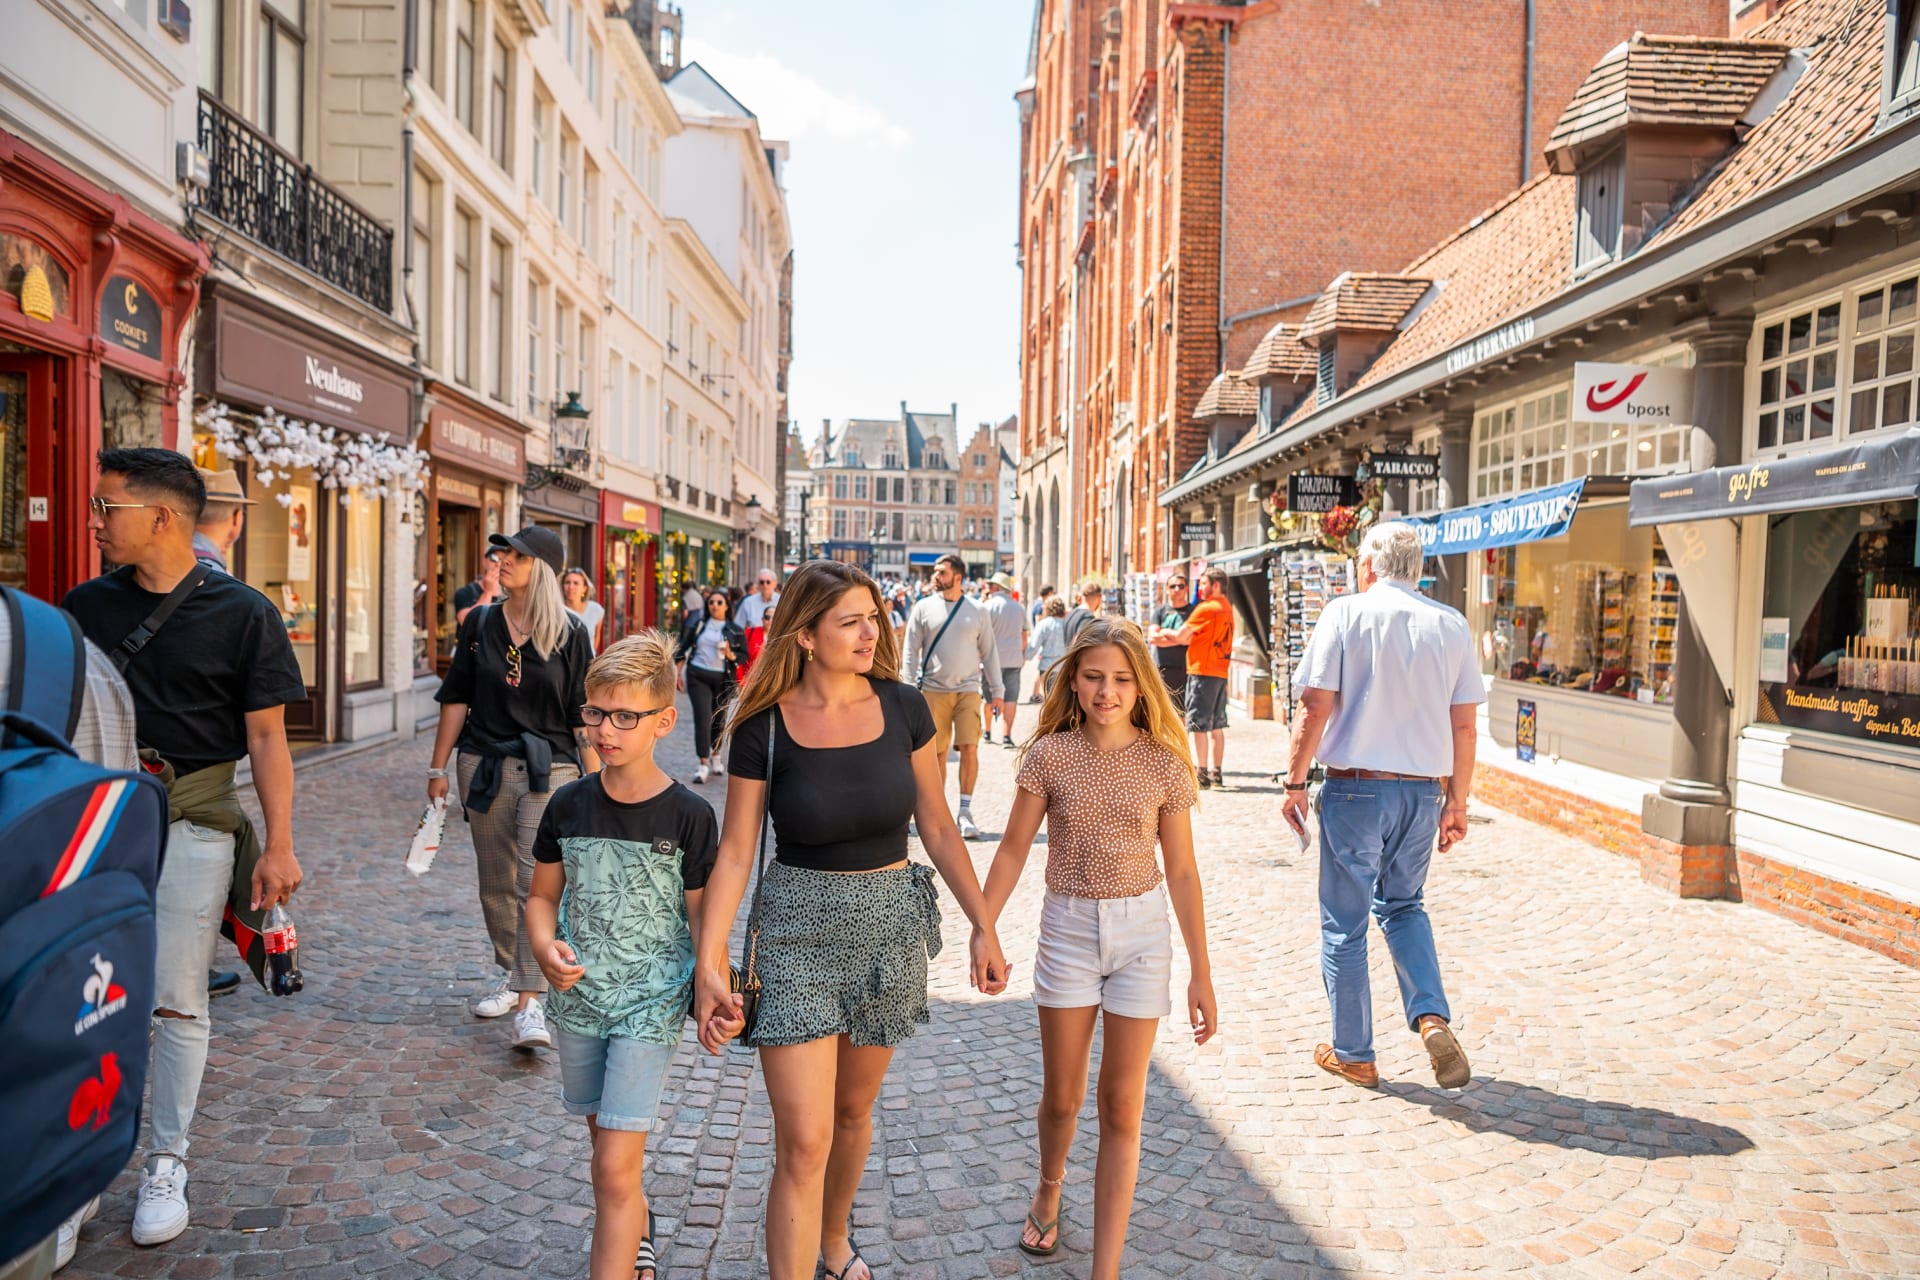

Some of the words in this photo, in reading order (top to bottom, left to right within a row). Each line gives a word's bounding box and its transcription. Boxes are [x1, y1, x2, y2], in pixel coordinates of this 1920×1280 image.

[114, 318, 148, 344] COOKIE'S
[1446, 342, 1476, 374] CHEZ
[1477, 316, 1535, 362] FERNAND
[305, 355, 363, 402] Neuhaus
[1627, 402, 1670, 418] bpost
[1374, 461, 1434, 475] TABACCO
[1298, 476, 1333, 493] MARZIPAN
[1335, 480, 1342, 493] &
[1728, 464, 1769, 502] go.fre
[33, 503, 45, 515] 14
[1442, 514, 1482, 544] LOTTO
[1786, 689, 1839, 712] Handmade
[1842, 699, 1879, 722] waffles
[1866, 720, 1891, 735] dipped
[1891, 723, 1899, 734] in
